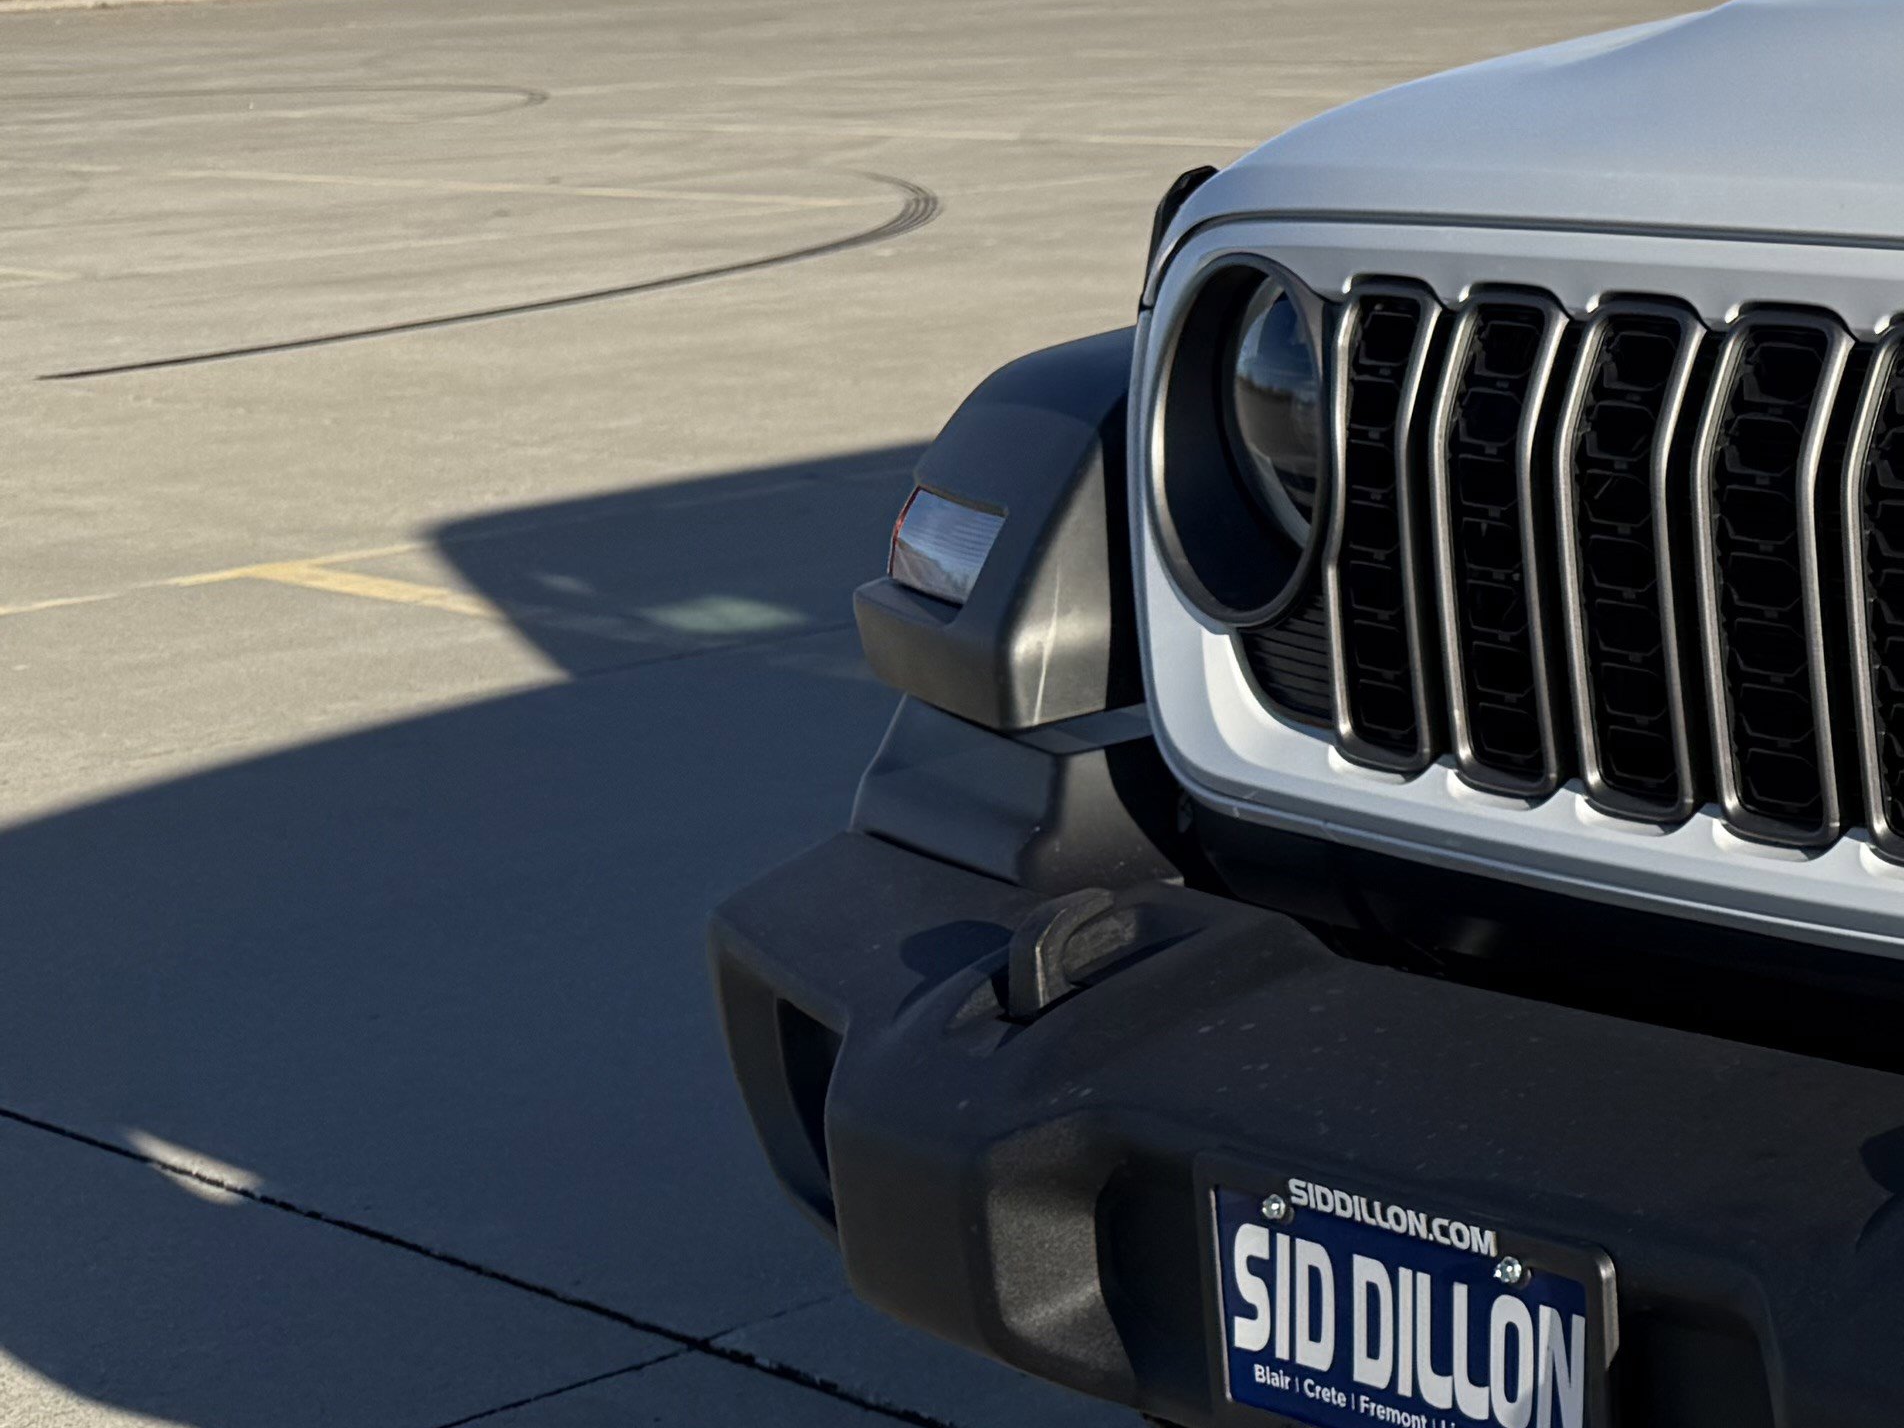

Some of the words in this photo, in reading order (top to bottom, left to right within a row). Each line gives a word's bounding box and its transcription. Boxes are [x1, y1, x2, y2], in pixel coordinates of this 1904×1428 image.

[1287, 1178, 1498, 1257] SIDDILLON.COM
[1232, 1221, 1336, 1374] SID
[1253, 1363, 1291, 1391] Blair
[1303, 1380, 1347, 1409] Crete
